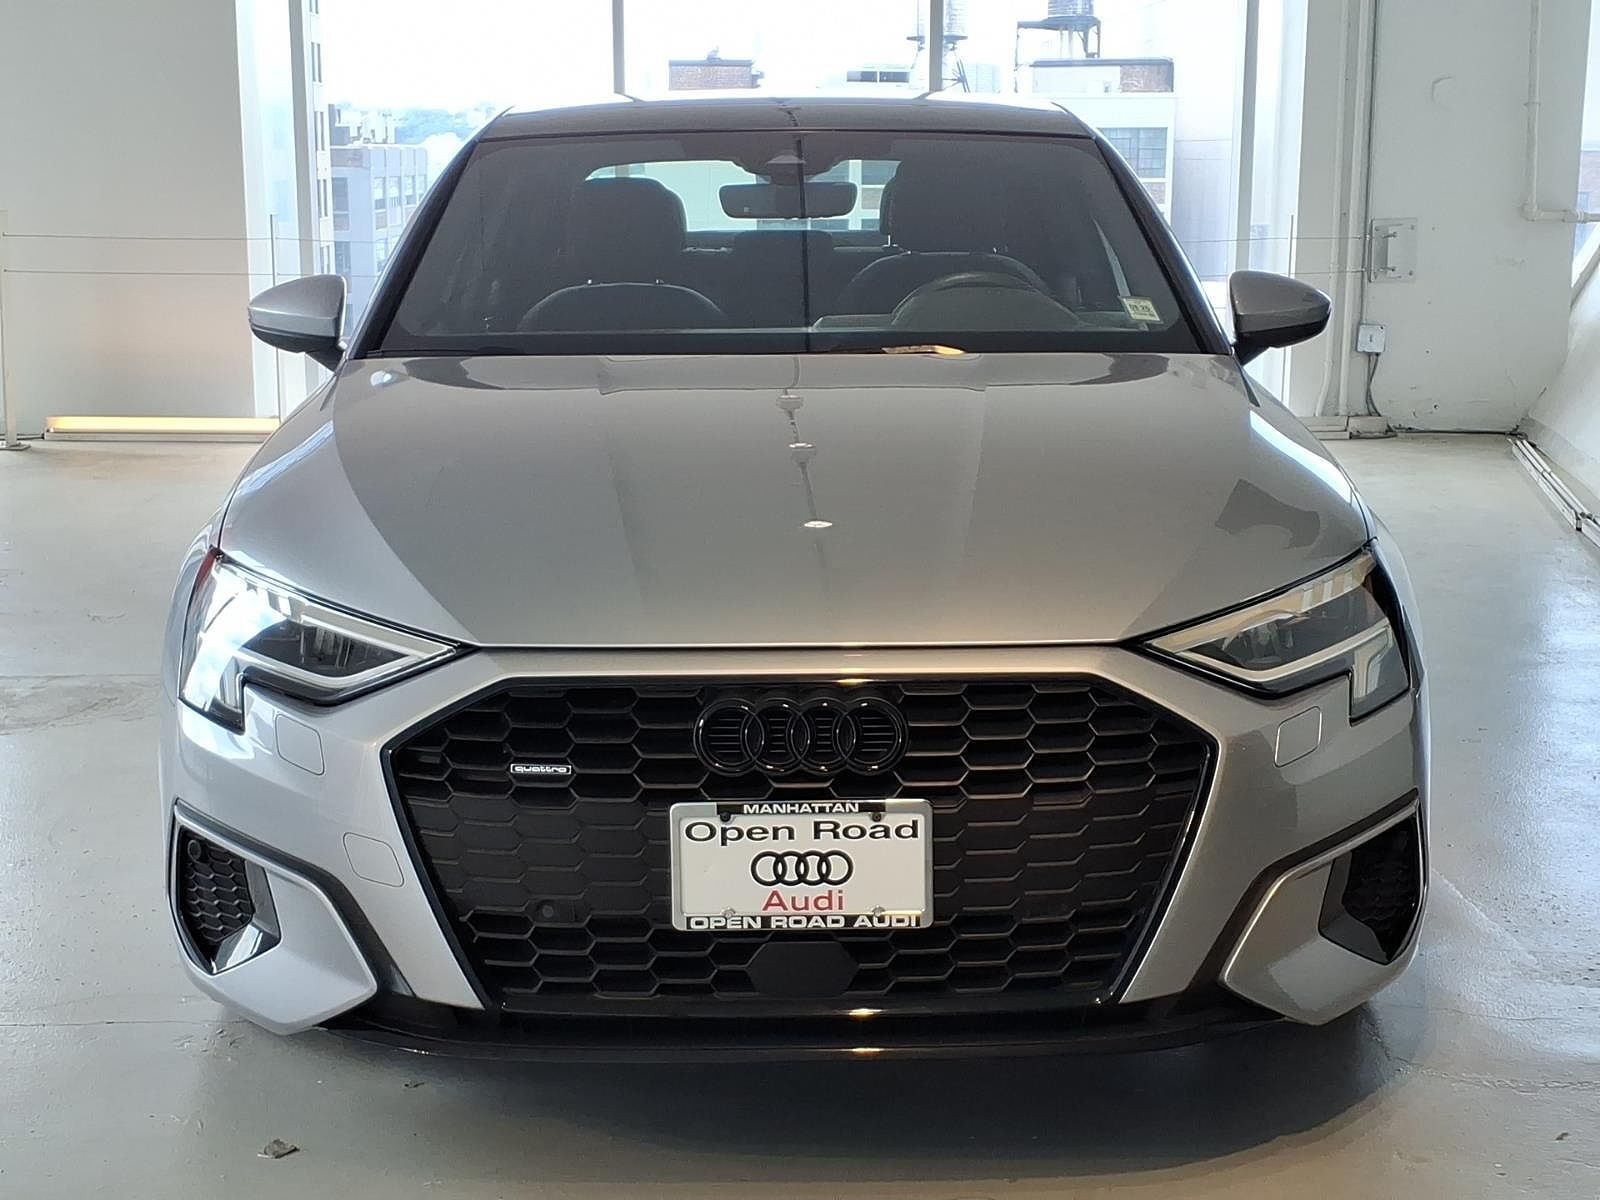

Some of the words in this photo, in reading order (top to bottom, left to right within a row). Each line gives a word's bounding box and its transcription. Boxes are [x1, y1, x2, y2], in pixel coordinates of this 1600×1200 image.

[743, 803, 859, 814] MANHATTAN
[685, 822, 795, 846] Open
[814, 820, 919, 840] Road
[762, 890, 844, 911] Audi
[690, 916, 761, 929] OPEN
[771, 916, 846, 929] ROAD
[854, 915, 916, 928] AUDI
